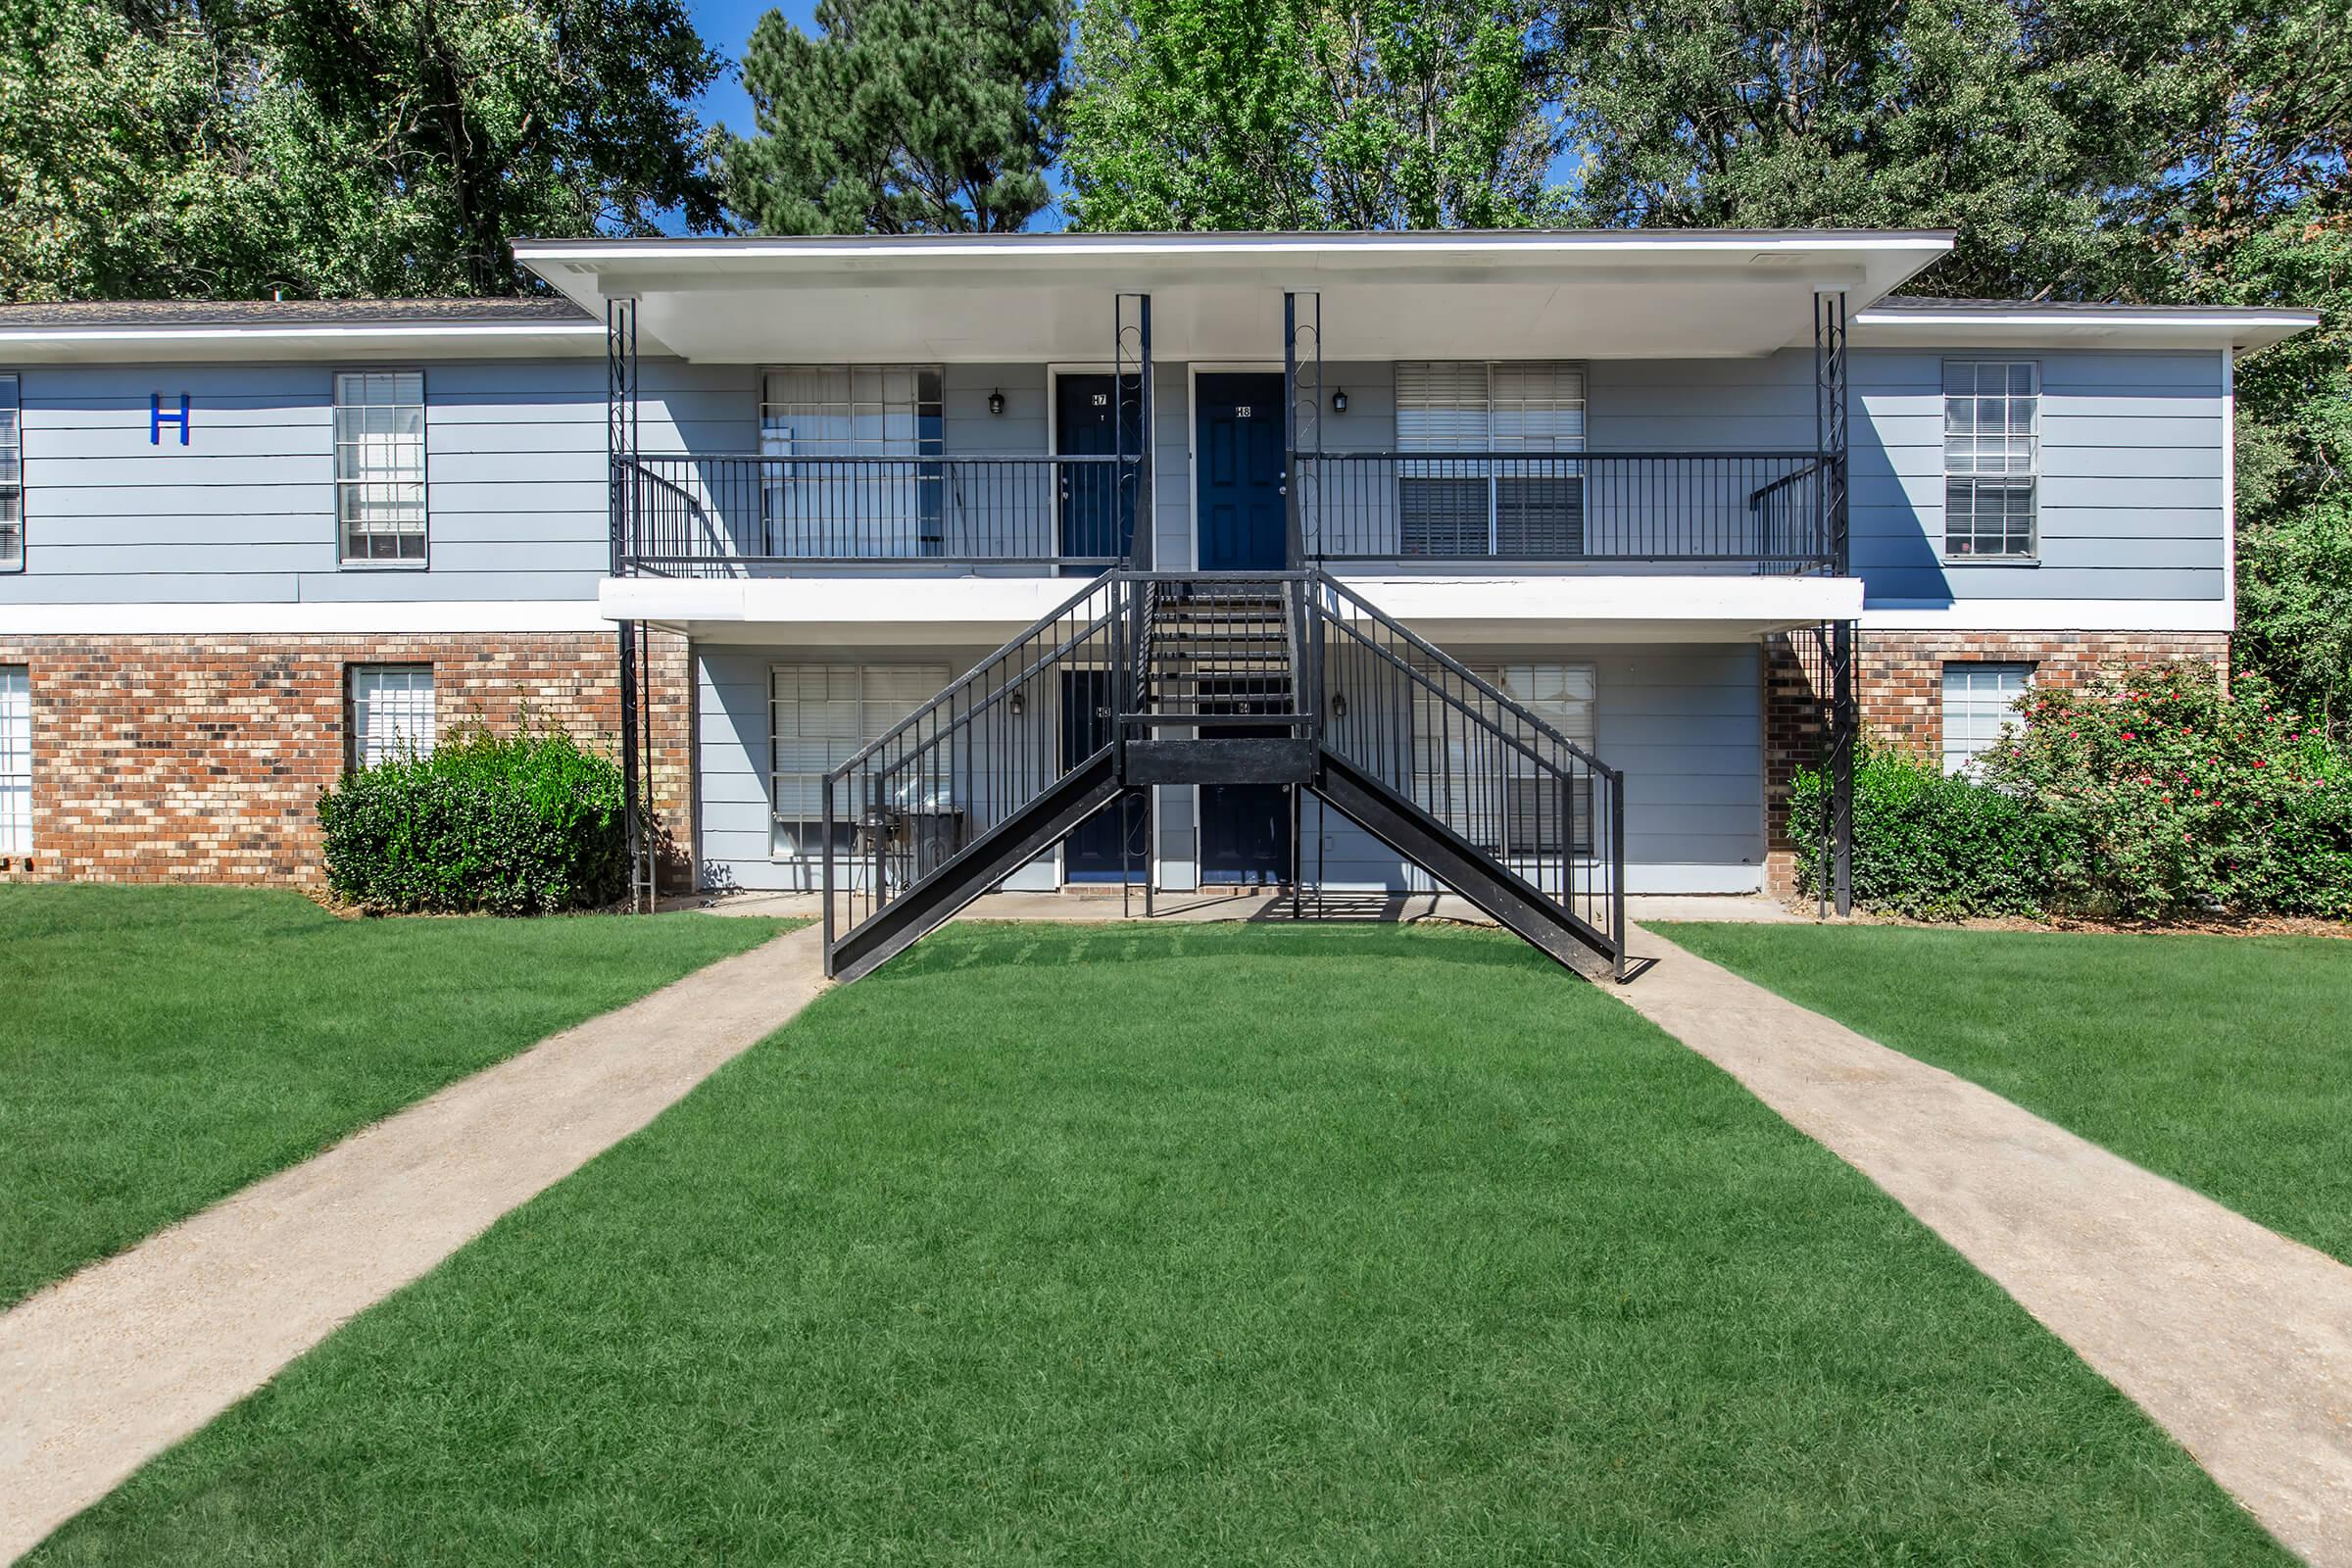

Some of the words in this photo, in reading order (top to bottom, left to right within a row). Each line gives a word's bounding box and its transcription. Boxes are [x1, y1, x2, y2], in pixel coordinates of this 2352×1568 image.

[1093, 394, 1106, 406] H7
[1236, 407, 1250, 417] H8
[150, 393, 190, 446] H
